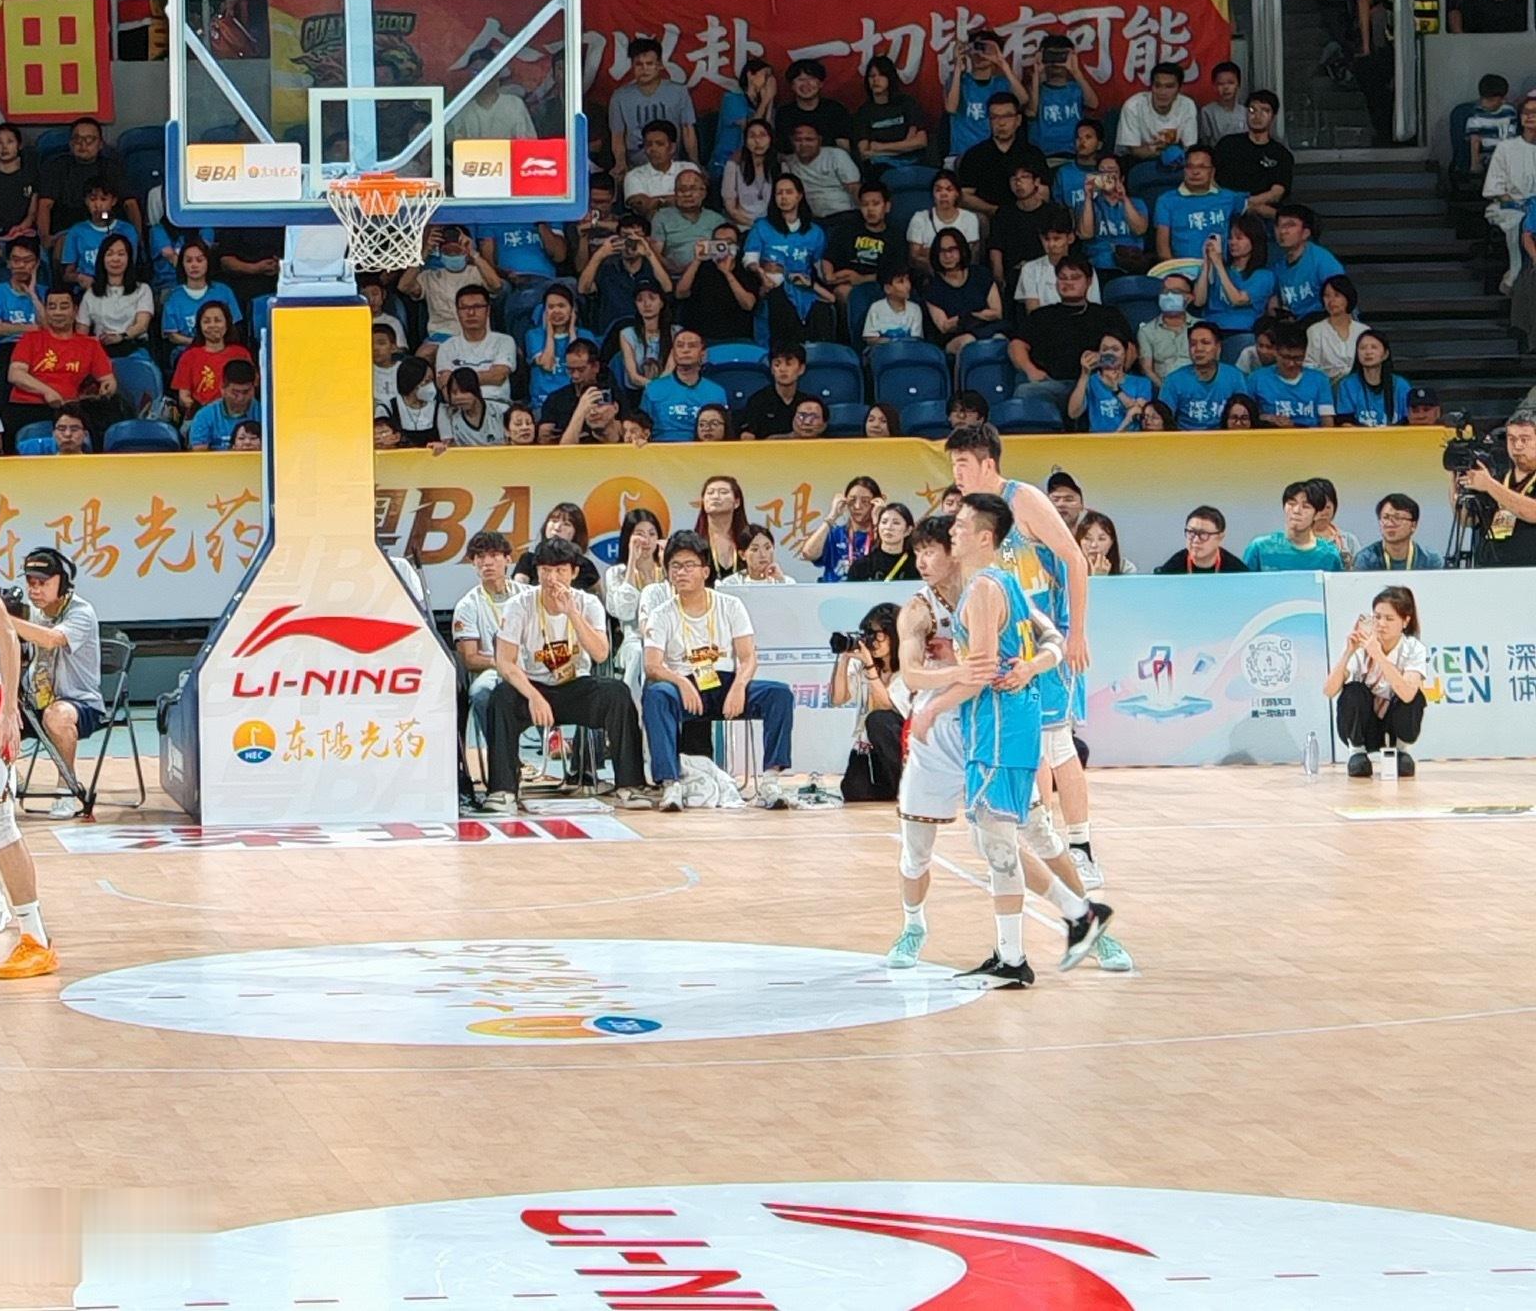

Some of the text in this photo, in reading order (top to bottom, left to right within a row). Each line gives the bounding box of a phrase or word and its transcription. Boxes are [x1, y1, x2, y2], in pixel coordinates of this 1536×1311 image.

[785, 3, 1200, 86] 一切皆有可能
[231, 667, 423, 698] LI-NING
